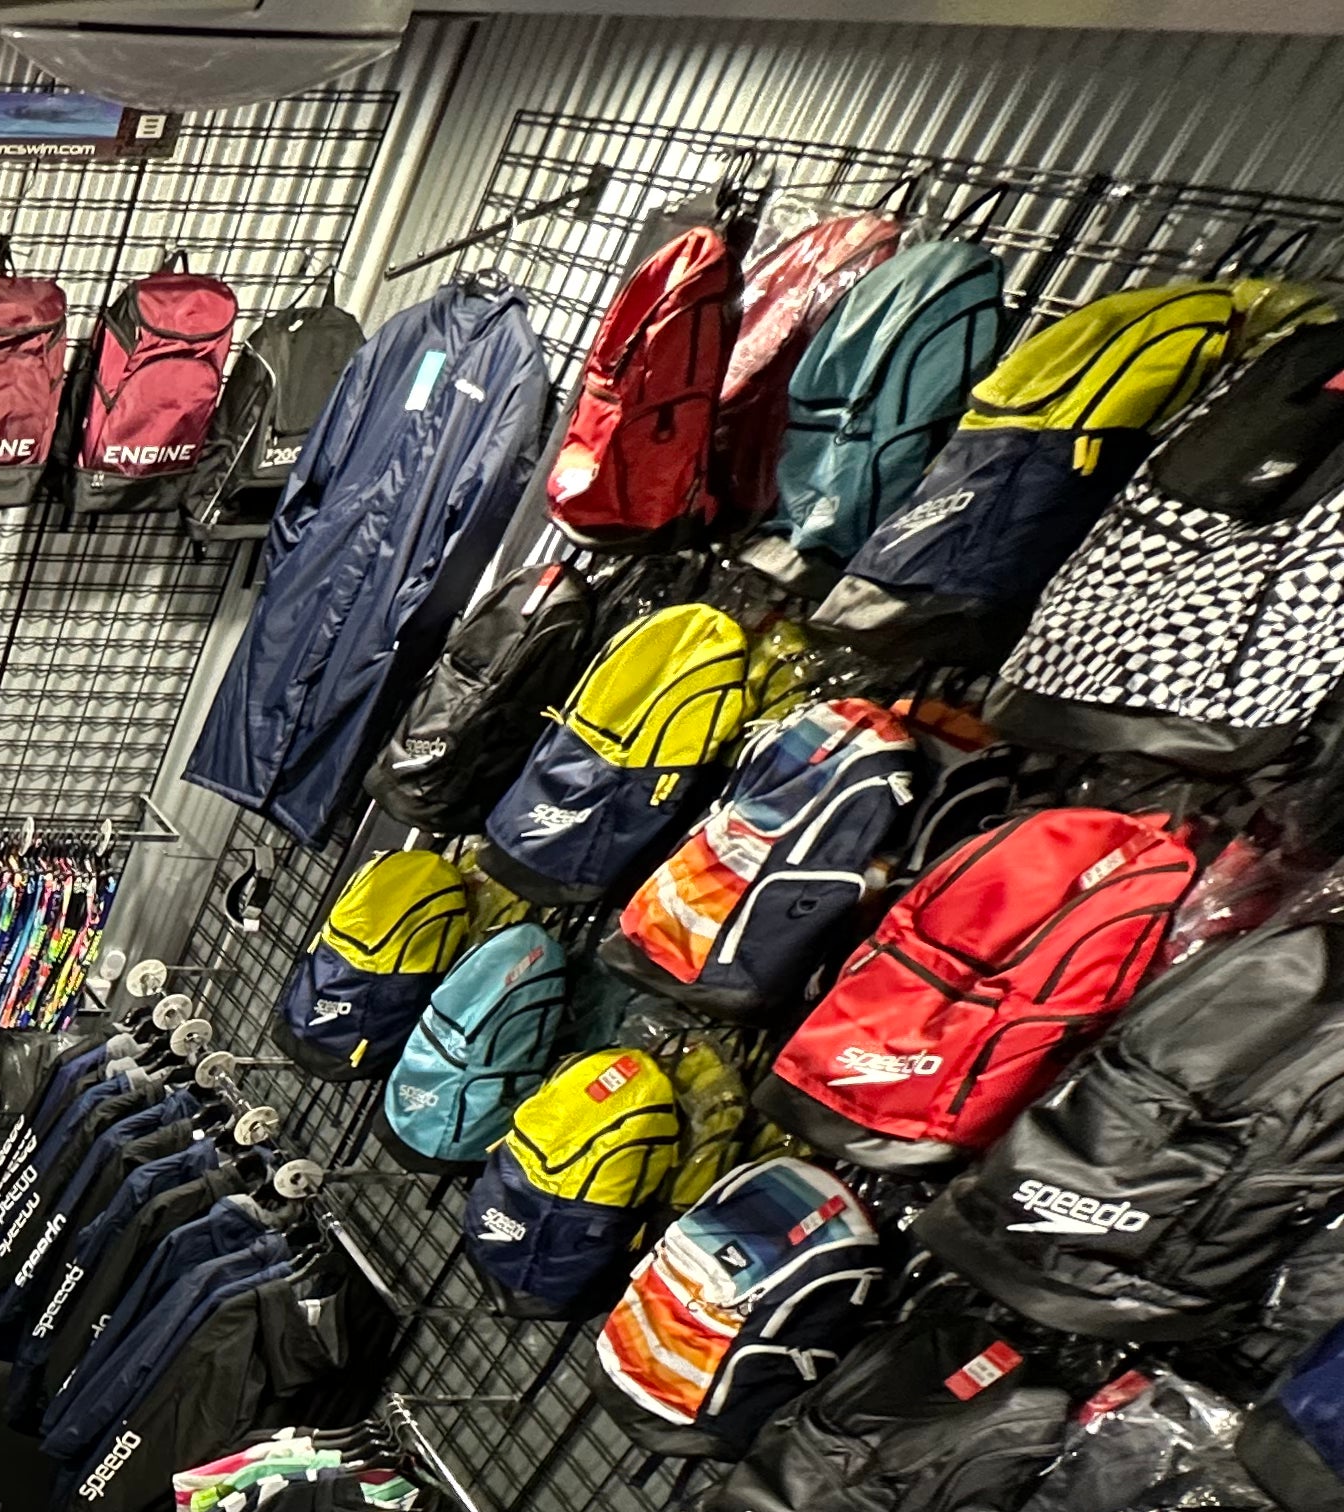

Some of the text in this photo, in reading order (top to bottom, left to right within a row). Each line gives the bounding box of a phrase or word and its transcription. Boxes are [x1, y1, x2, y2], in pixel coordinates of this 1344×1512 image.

[103, 443, 196, 465] ENGINE
[836, 1047, 943, 1075] speedo
[1012, 1180, 1150, 1231] speedo
[79, 1431, 141, 1501] speedo
